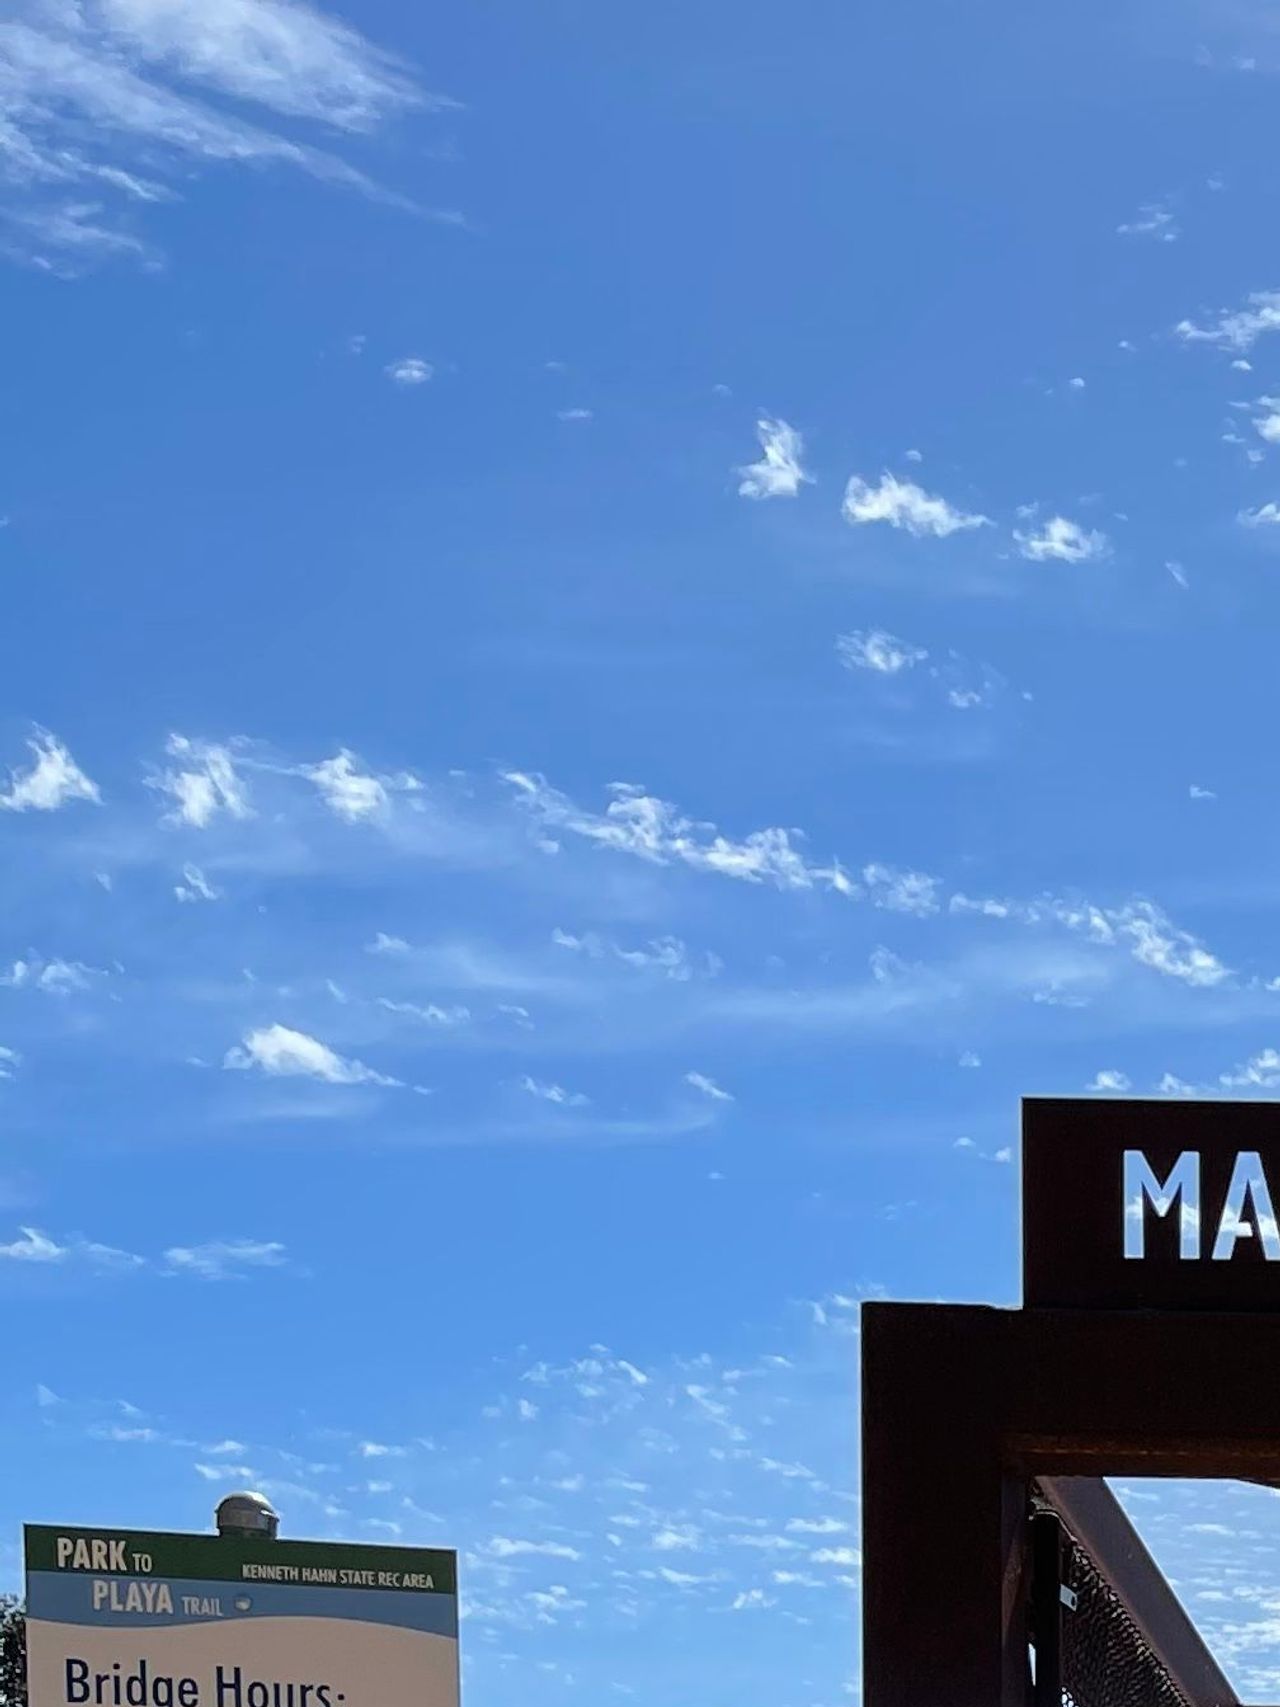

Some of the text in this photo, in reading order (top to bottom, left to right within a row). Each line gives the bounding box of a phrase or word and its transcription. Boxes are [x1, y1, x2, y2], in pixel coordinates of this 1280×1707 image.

[56, 1537, 152, 1572] PARK TO
[242, 1564, 434, 1589] KENNETH HAHN STATE REC AREA
[93, 1581, 224, 1617] PLAYA TRAIL
